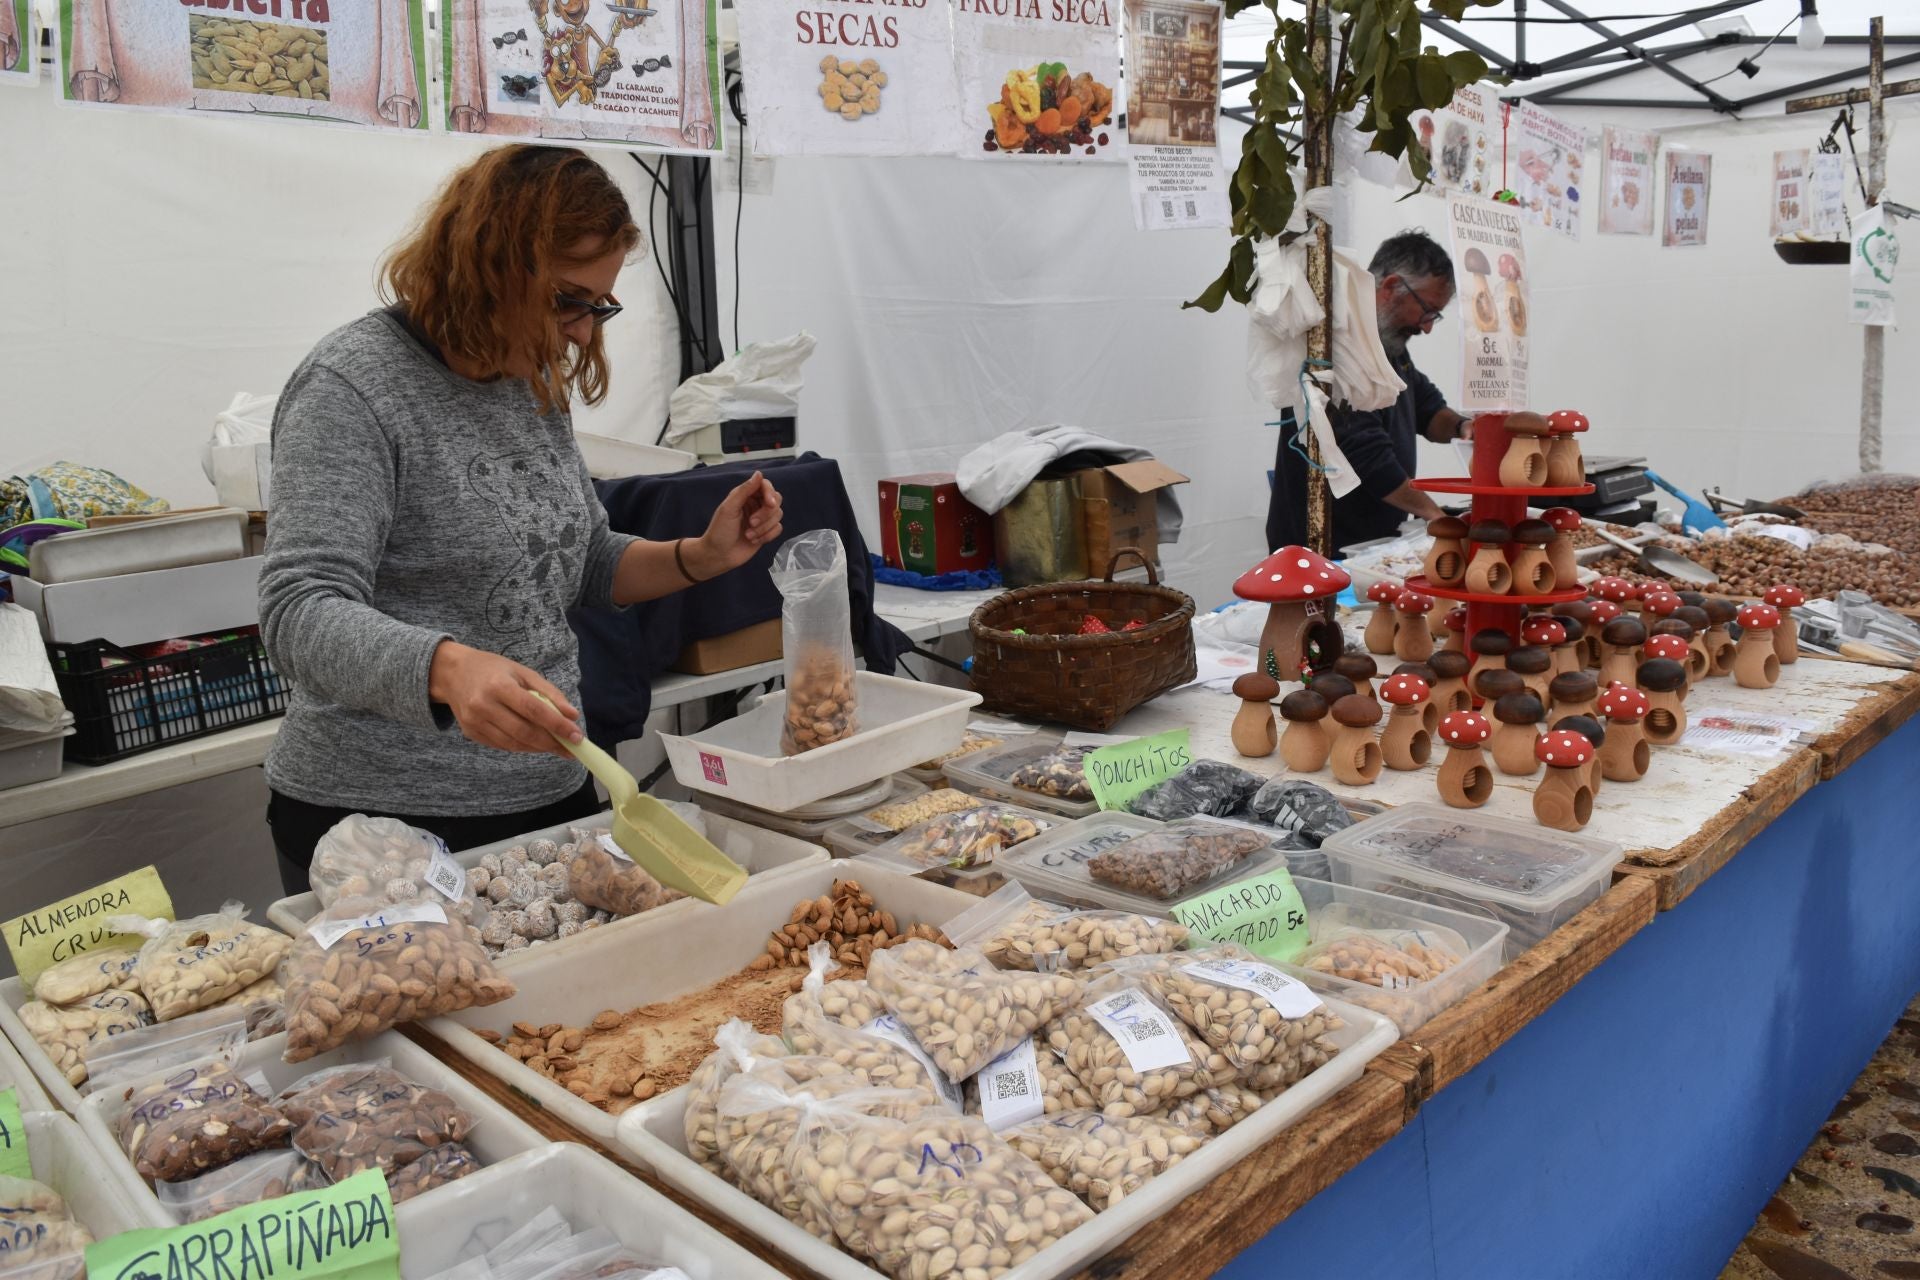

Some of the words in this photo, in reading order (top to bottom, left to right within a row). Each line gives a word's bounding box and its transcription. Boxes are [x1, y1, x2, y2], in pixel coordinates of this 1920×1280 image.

[1052, 0, 1111, 26] SECA
[796, 10, 899, 48] SECAS
[601, 91, 650, 103] TRADICIONAL
[651, 96, 661, 104] DE
[616, 82, 625, 90] EL
[625, 83, 664, 93] CARAMELO
[604, 104, 629, 113] CACAO
[631, 106, 636, 114] Y
[639, 107, 679, 117] CACAHUETE
[1457, 104, 1466, 117] DE
[1468, 109, 1485, 126] HAYA
[1155, 147, 1174, 155] FRUTOS
[1453, 202, 1519, 234] CASCANUECES
[1457, 226, 1466, 240] DE
[1467, 227, 1494, 246] MADERA
[1494, 234, 1504, 247] DE
[1476, 356, 1504, 367] NORMAL
[1481, 369, 1496, 378] PARA
[1468, 380, 1510, 389] AVELLANAS
[19, 889, 131, 947] ALMENDRA
[1181, 883, 1282, 934] ANACARDO
[53, 927, 125, 962] CRU
